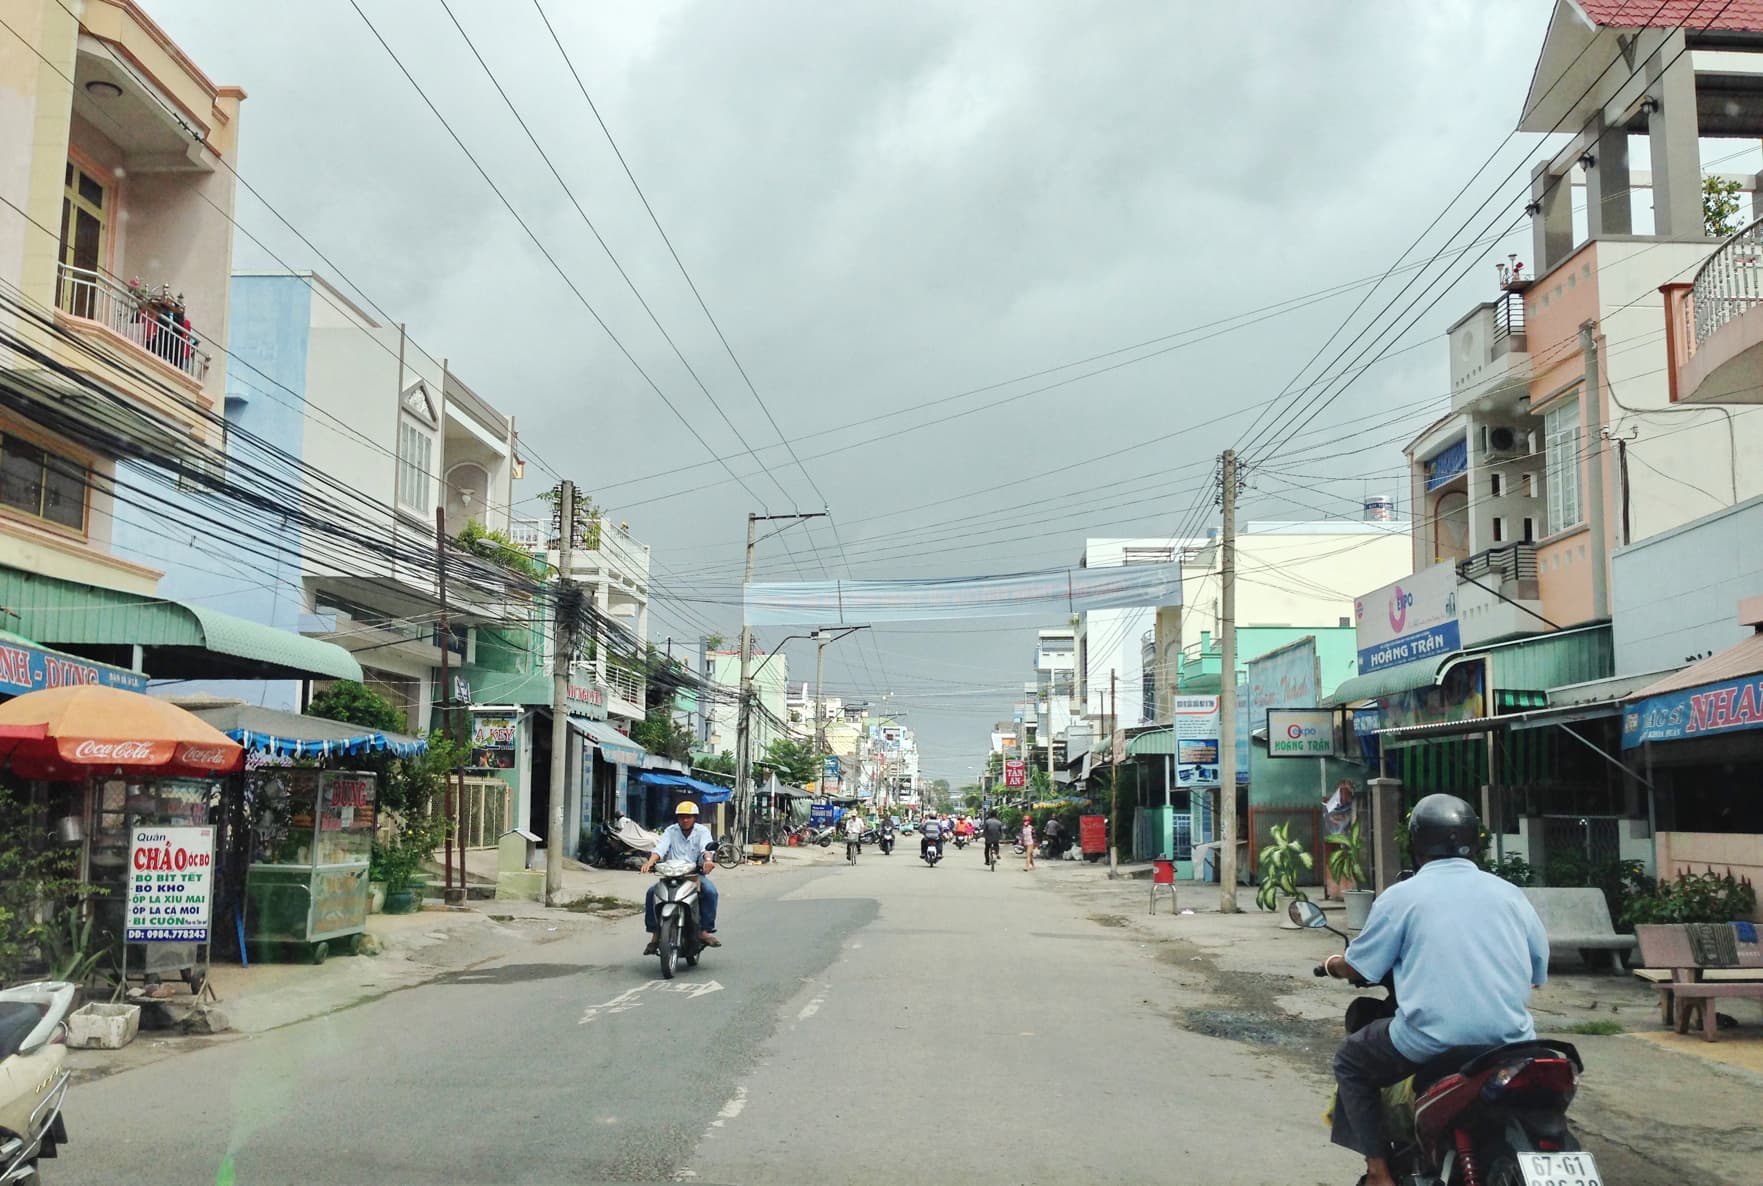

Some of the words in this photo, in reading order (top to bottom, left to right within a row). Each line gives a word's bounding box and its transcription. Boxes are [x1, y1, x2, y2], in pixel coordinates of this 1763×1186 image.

[1371, 645, 1408, 667] HOÀNG
[1685, 682, 1763, 732] NHA
[75, 740, 152, 760] Coca-Cola
[157, 884, 185, 893] KHO
